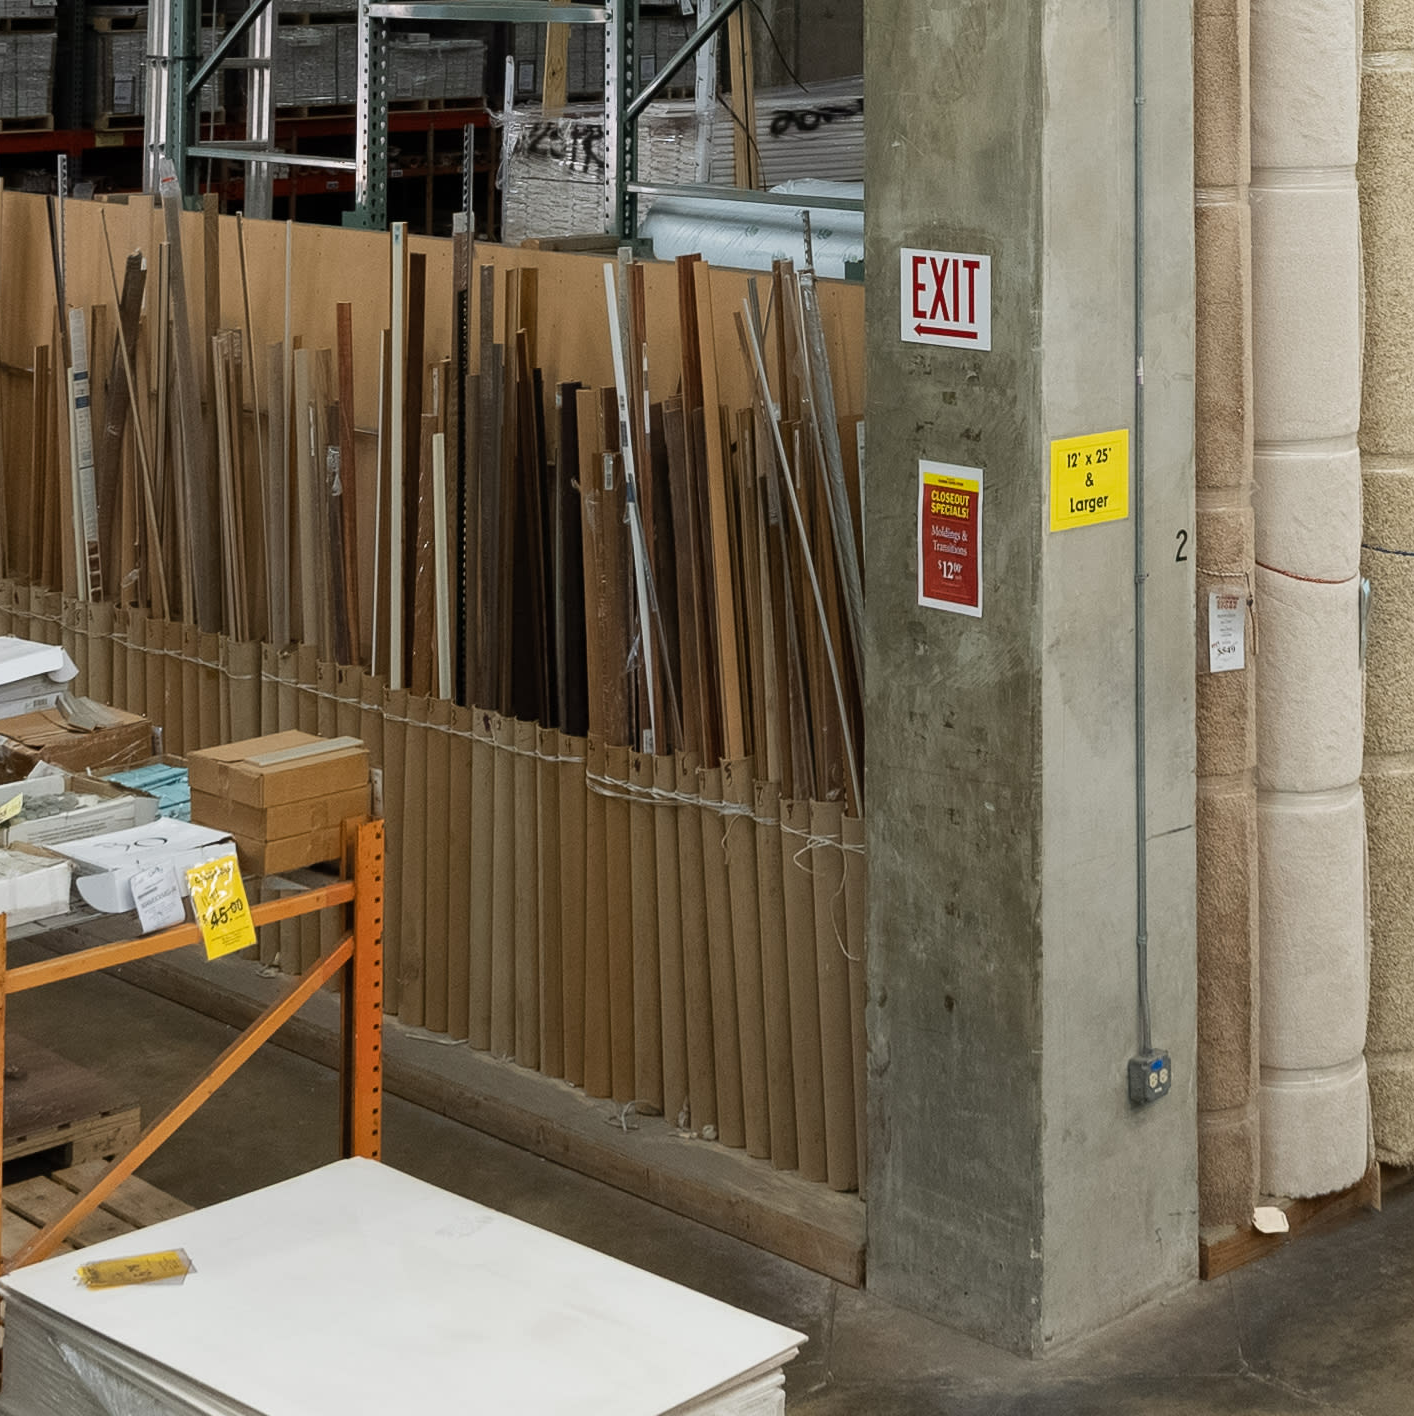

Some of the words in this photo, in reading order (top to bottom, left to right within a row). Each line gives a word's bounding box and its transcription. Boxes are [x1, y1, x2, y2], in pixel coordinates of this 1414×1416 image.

[912, 256, 980, 324] EXIT
[1067, 452, 1081, 468] 12'
[1085, 454, 1092, 466] x
[1096, 447, 1112, 464] 25'
[1085, 472, 1094, 488] &
[931, 489, 970, 507] CLOSEOUT
[1070, 493, 1109, 515] Larger
[930, 502, 970, 520] SPECIALS!
[931, 525, 961, 543] Moldings
[961, 530, 968, 542] &
[932, 539, 968, 556] Transitions
[1175, 529, 1188, 563] 2
